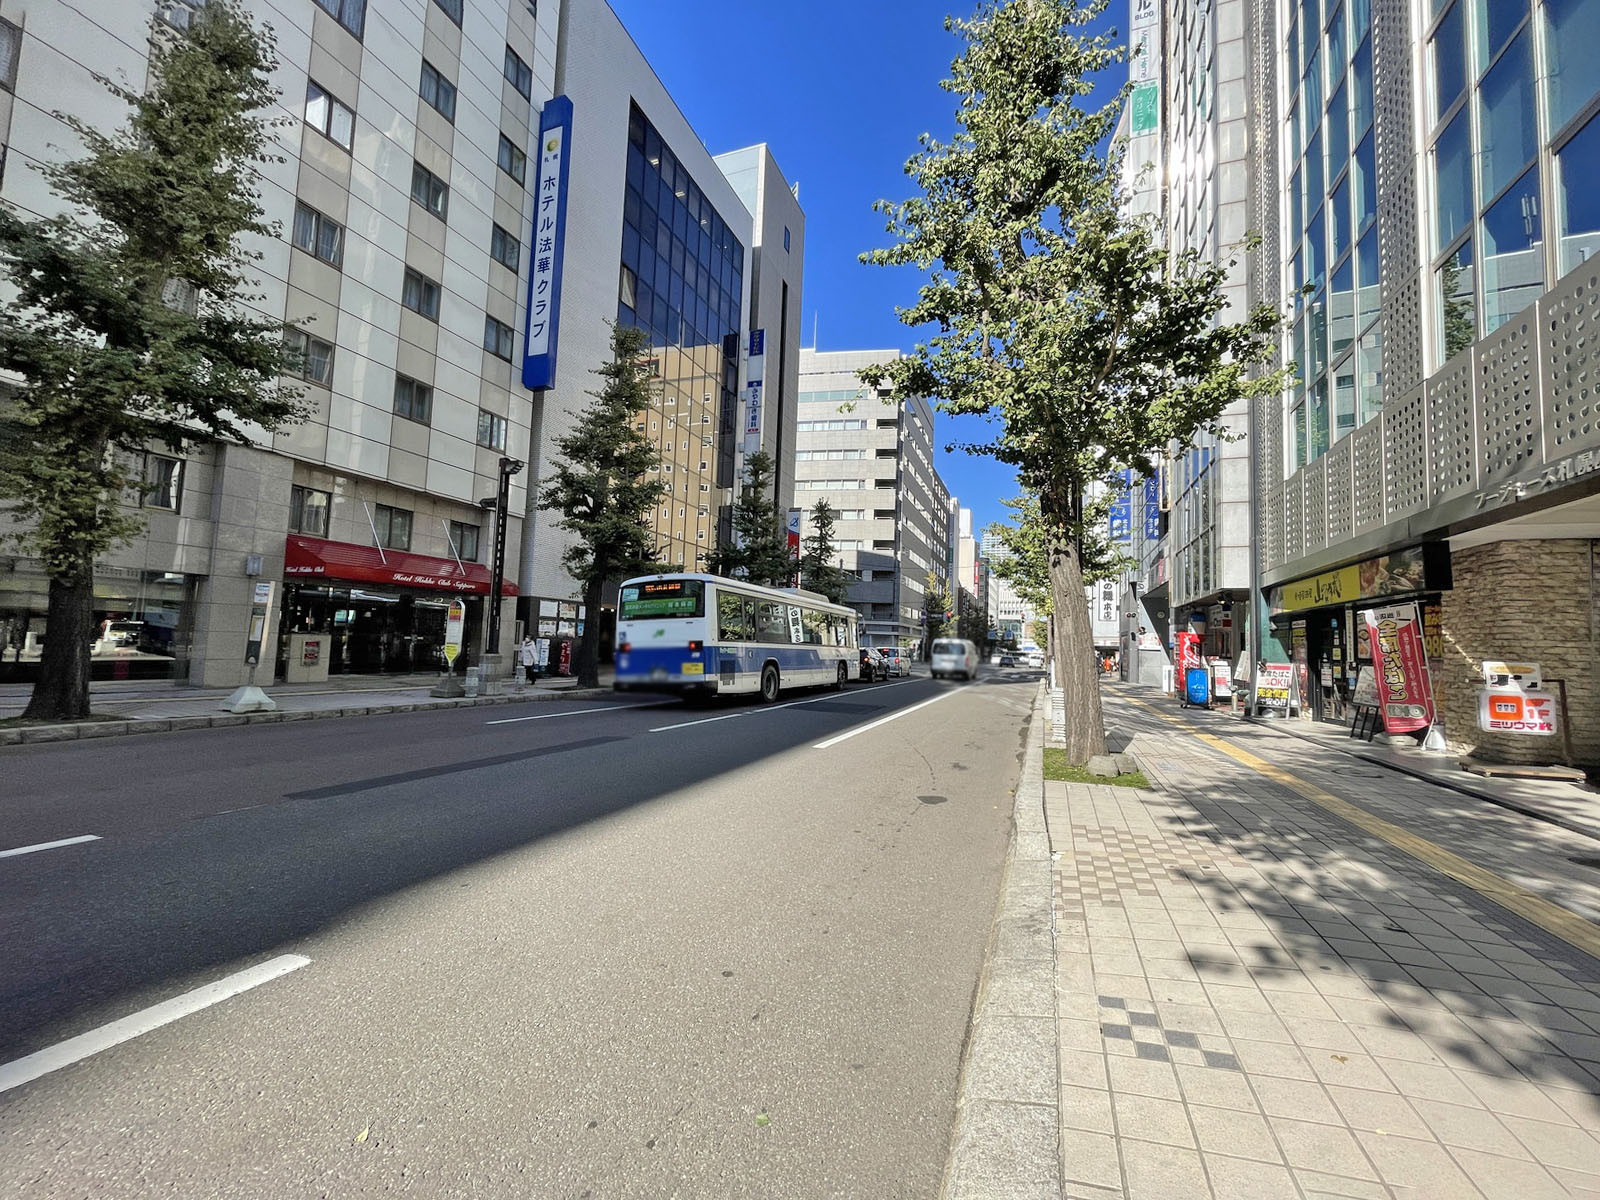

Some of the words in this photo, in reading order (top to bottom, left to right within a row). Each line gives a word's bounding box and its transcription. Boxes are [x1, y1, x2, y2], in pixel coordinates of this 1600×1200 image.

[533, 175, 556, 338] ホテル法華クラブ
[393, 573, 413, 583] Hotel
[1527, 708, 1550, 720] 1F
